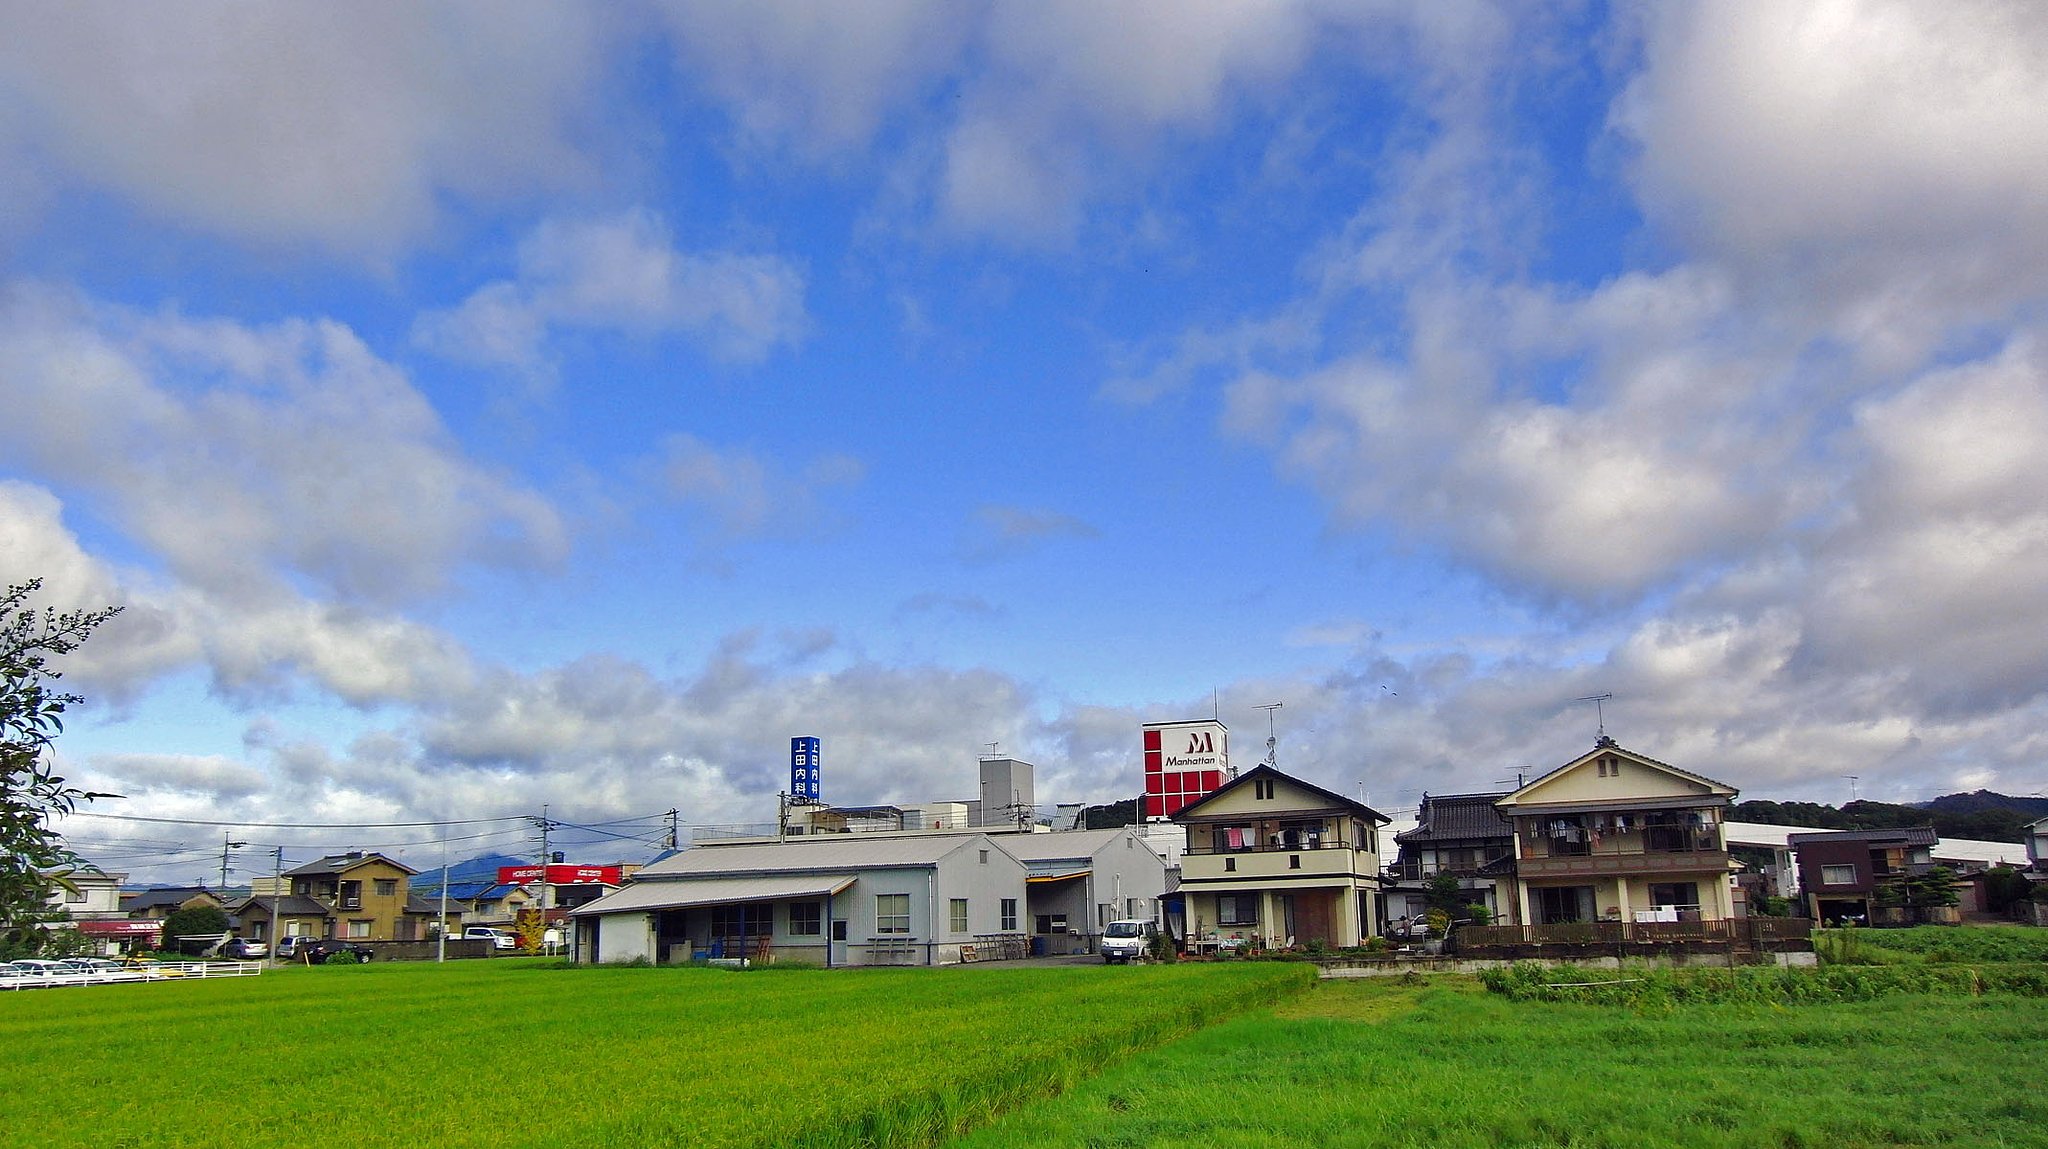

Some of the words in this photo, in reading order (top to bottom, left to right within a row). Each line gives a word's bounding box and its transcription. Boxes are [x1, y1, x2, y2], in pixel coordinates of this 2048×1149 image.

[795, 741, 806, 794] 上田内科
[1165, 756, 1215, 766] Manhattan
